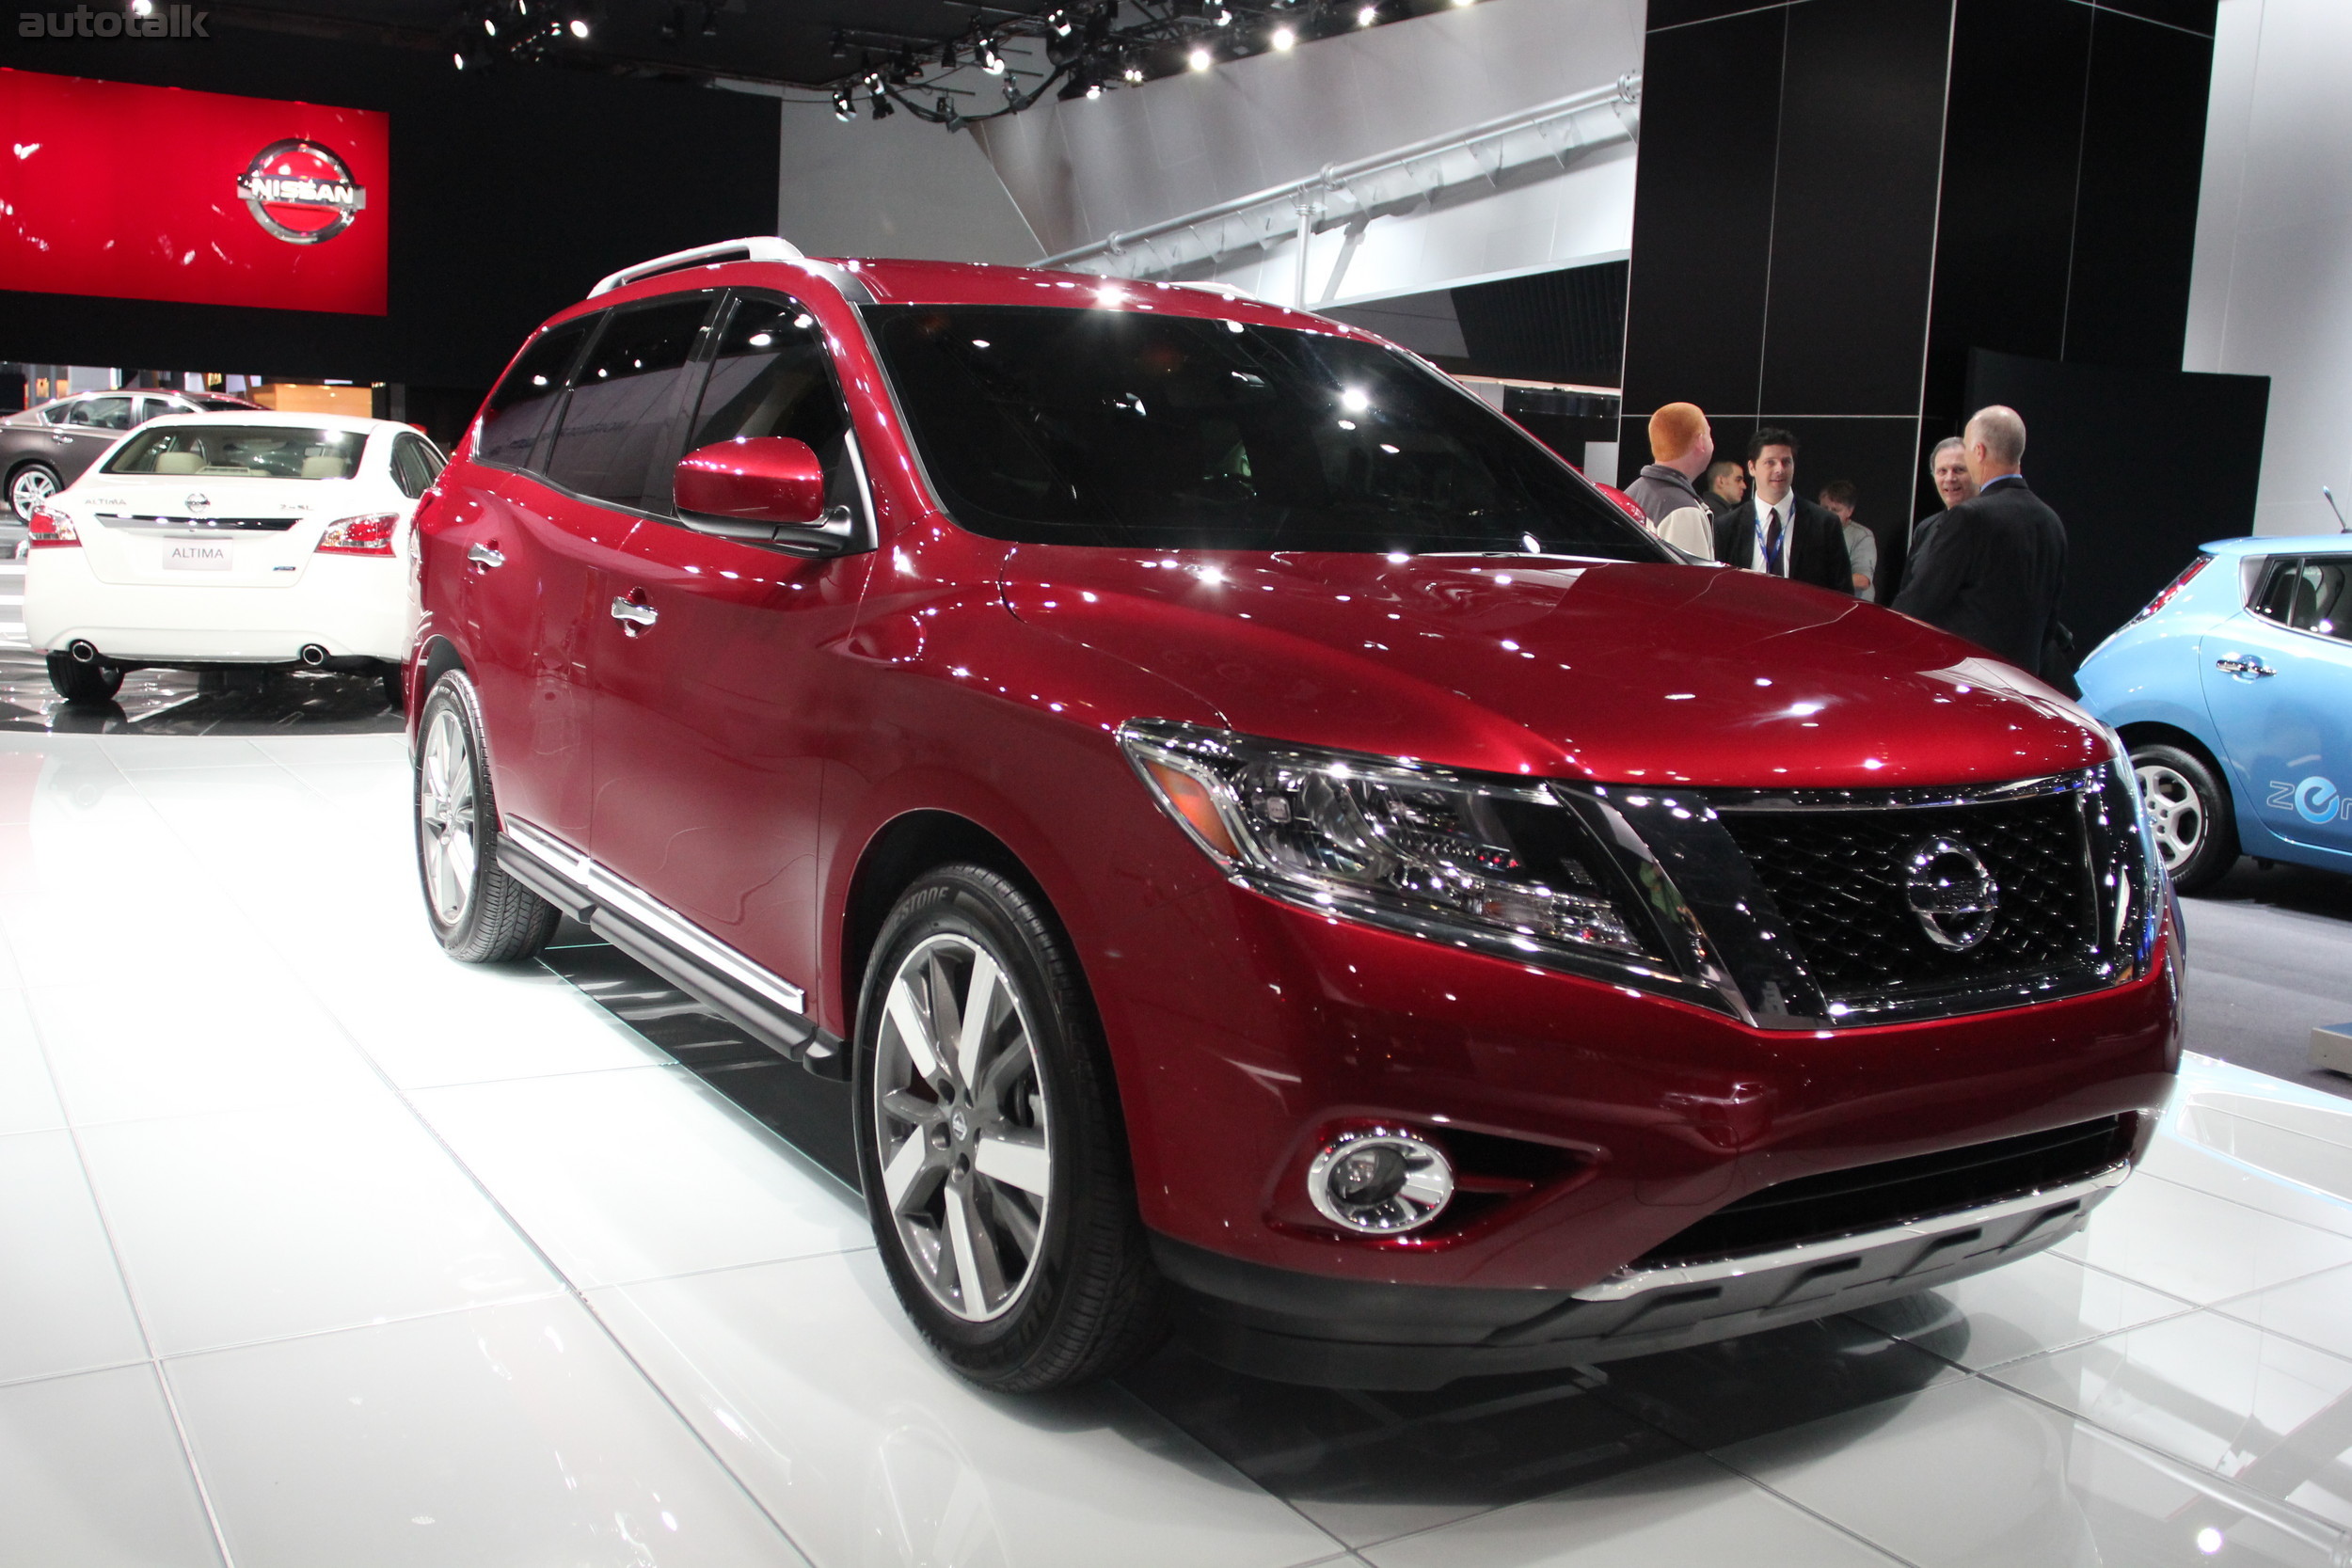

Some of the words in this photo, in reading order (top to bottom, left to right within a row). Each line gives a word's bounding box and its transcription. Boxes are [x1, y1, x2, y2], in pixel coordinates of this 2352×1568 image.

[250, 177, 354, 204] NISSAN
[85, 498, 127, 506] ALTIMA
[171, 547, 224, 560] ALTIMA
